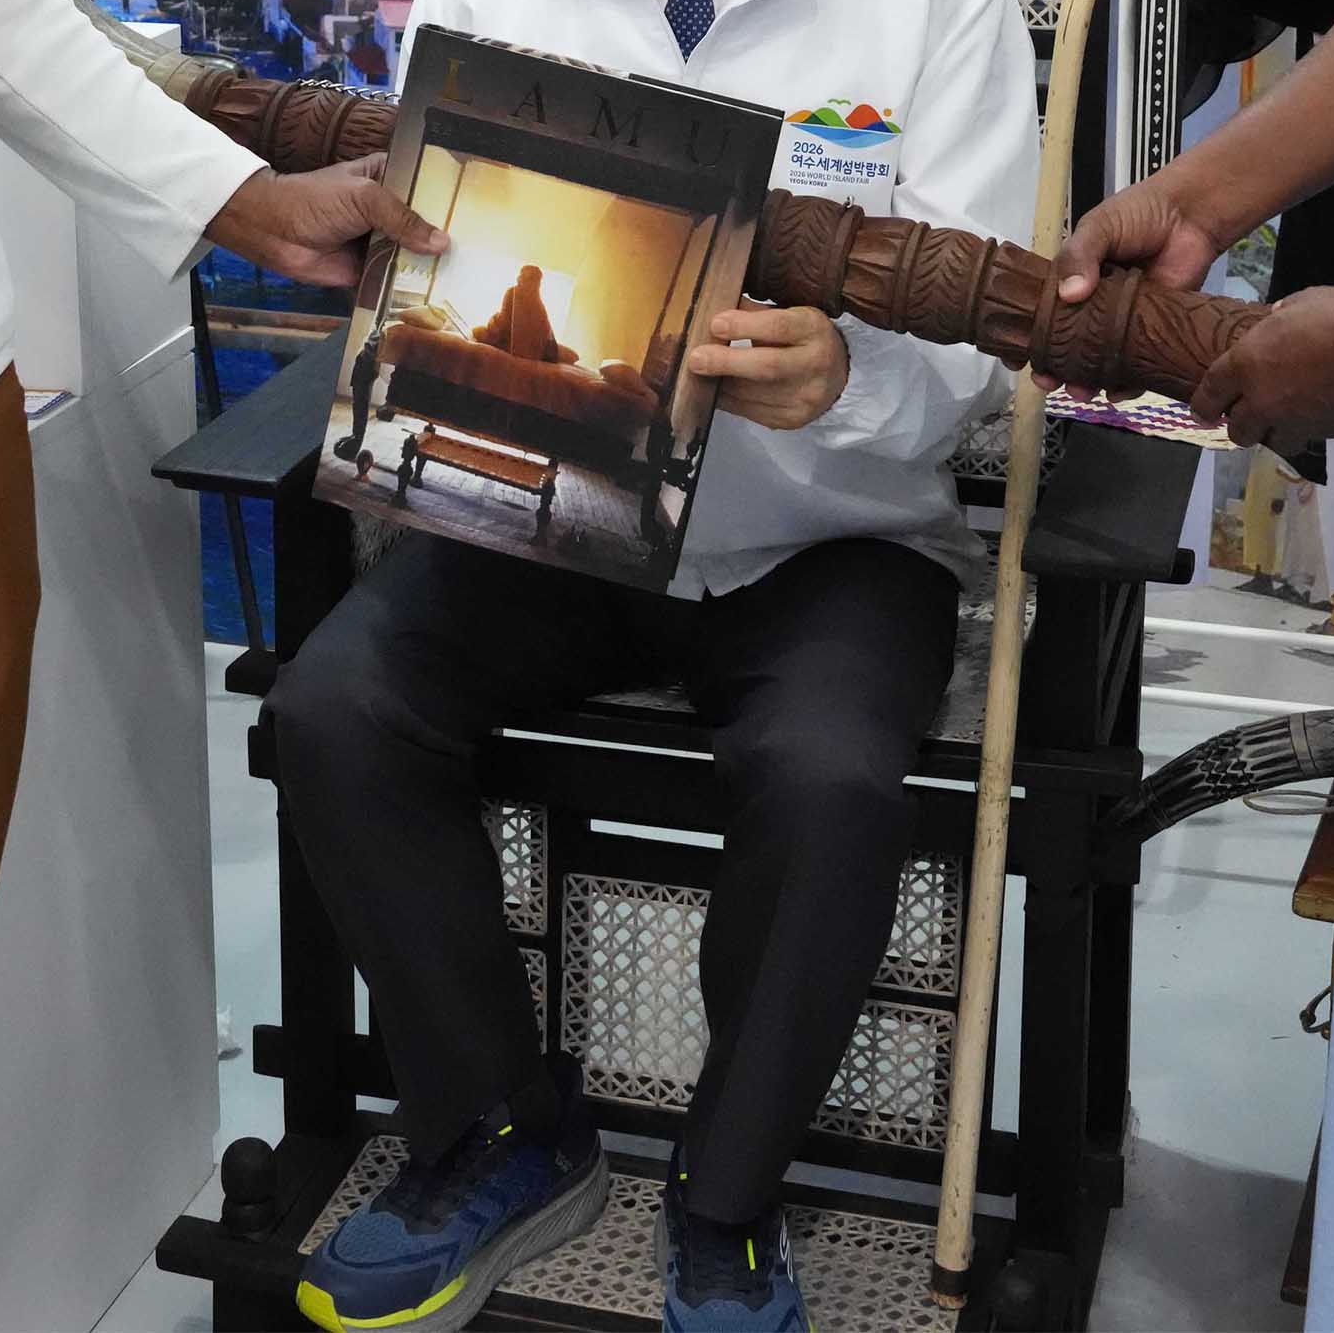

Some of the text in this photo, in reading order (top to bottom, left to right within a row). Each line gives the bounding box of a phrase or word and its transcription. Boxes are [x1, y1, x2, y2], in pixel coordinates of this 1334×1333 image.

[440, 57, 732, 168] LAMU
[793, 141, 824, 155] 2026
[791, 154, 890, 178] 여수세계섬박람회
[789, 169, 870, 185] 2026 WORLD ISLAND FAIR
[789, 178, 828, 187] YEOSU KOREA
